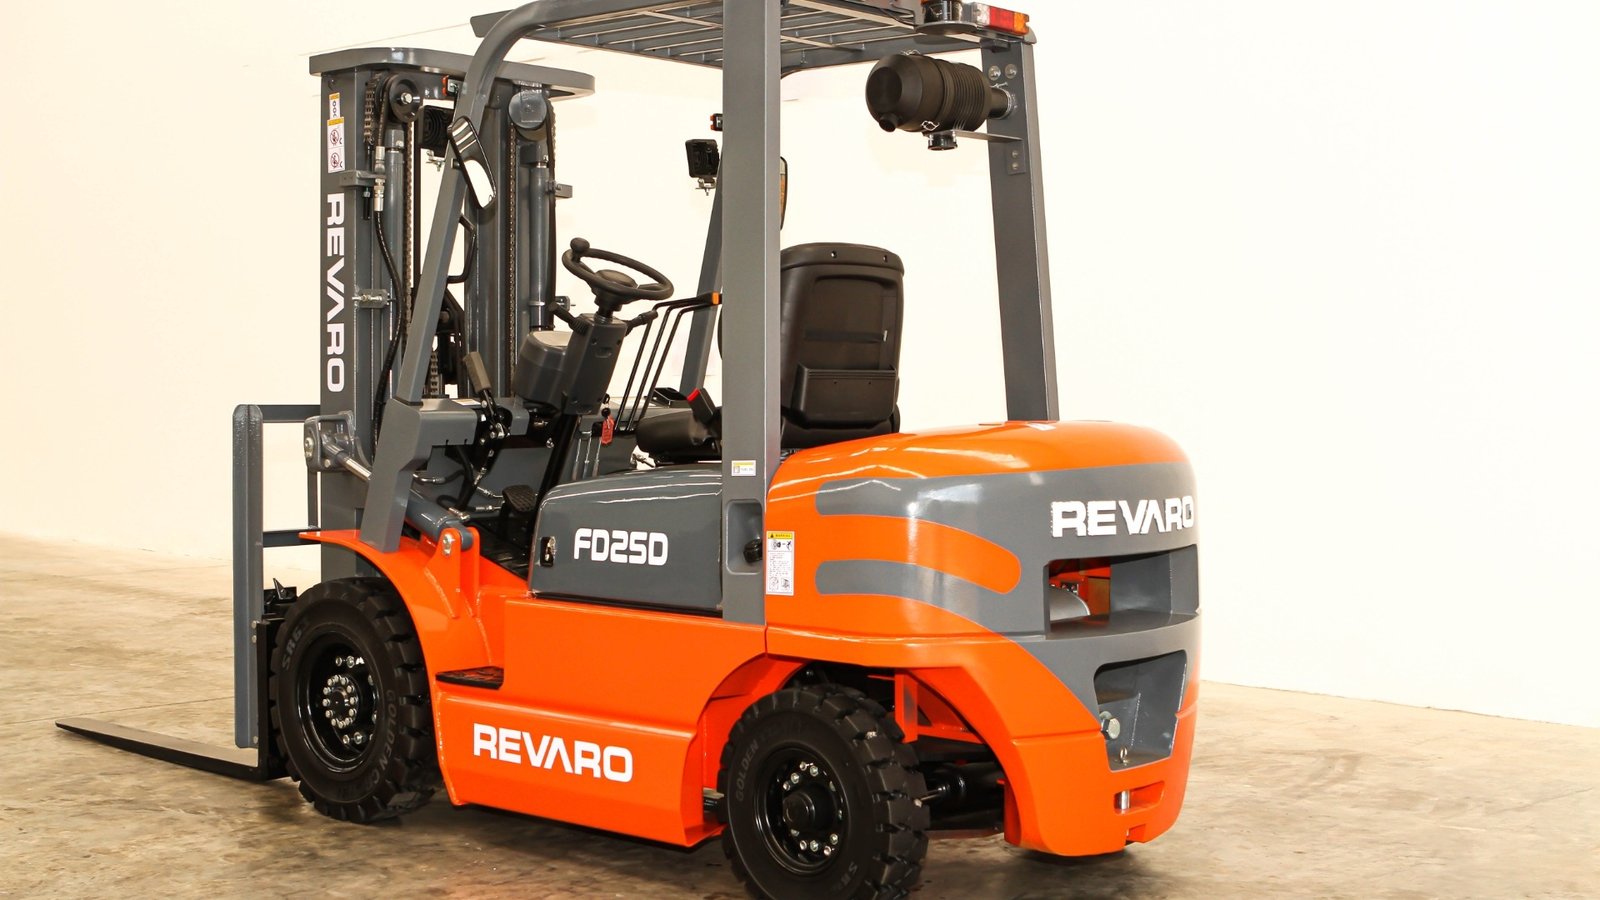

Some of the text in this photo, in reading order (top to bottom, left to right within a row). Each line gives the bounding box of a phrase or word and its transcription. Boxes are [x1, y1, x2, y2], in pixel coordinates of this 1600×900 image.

[327, 193, 345, 392] REVARO
[1051, 495, 1194, 538] REVARO
[573, 527, 669, 566] FD25D
[473, 722, 633, 783] REVARO
